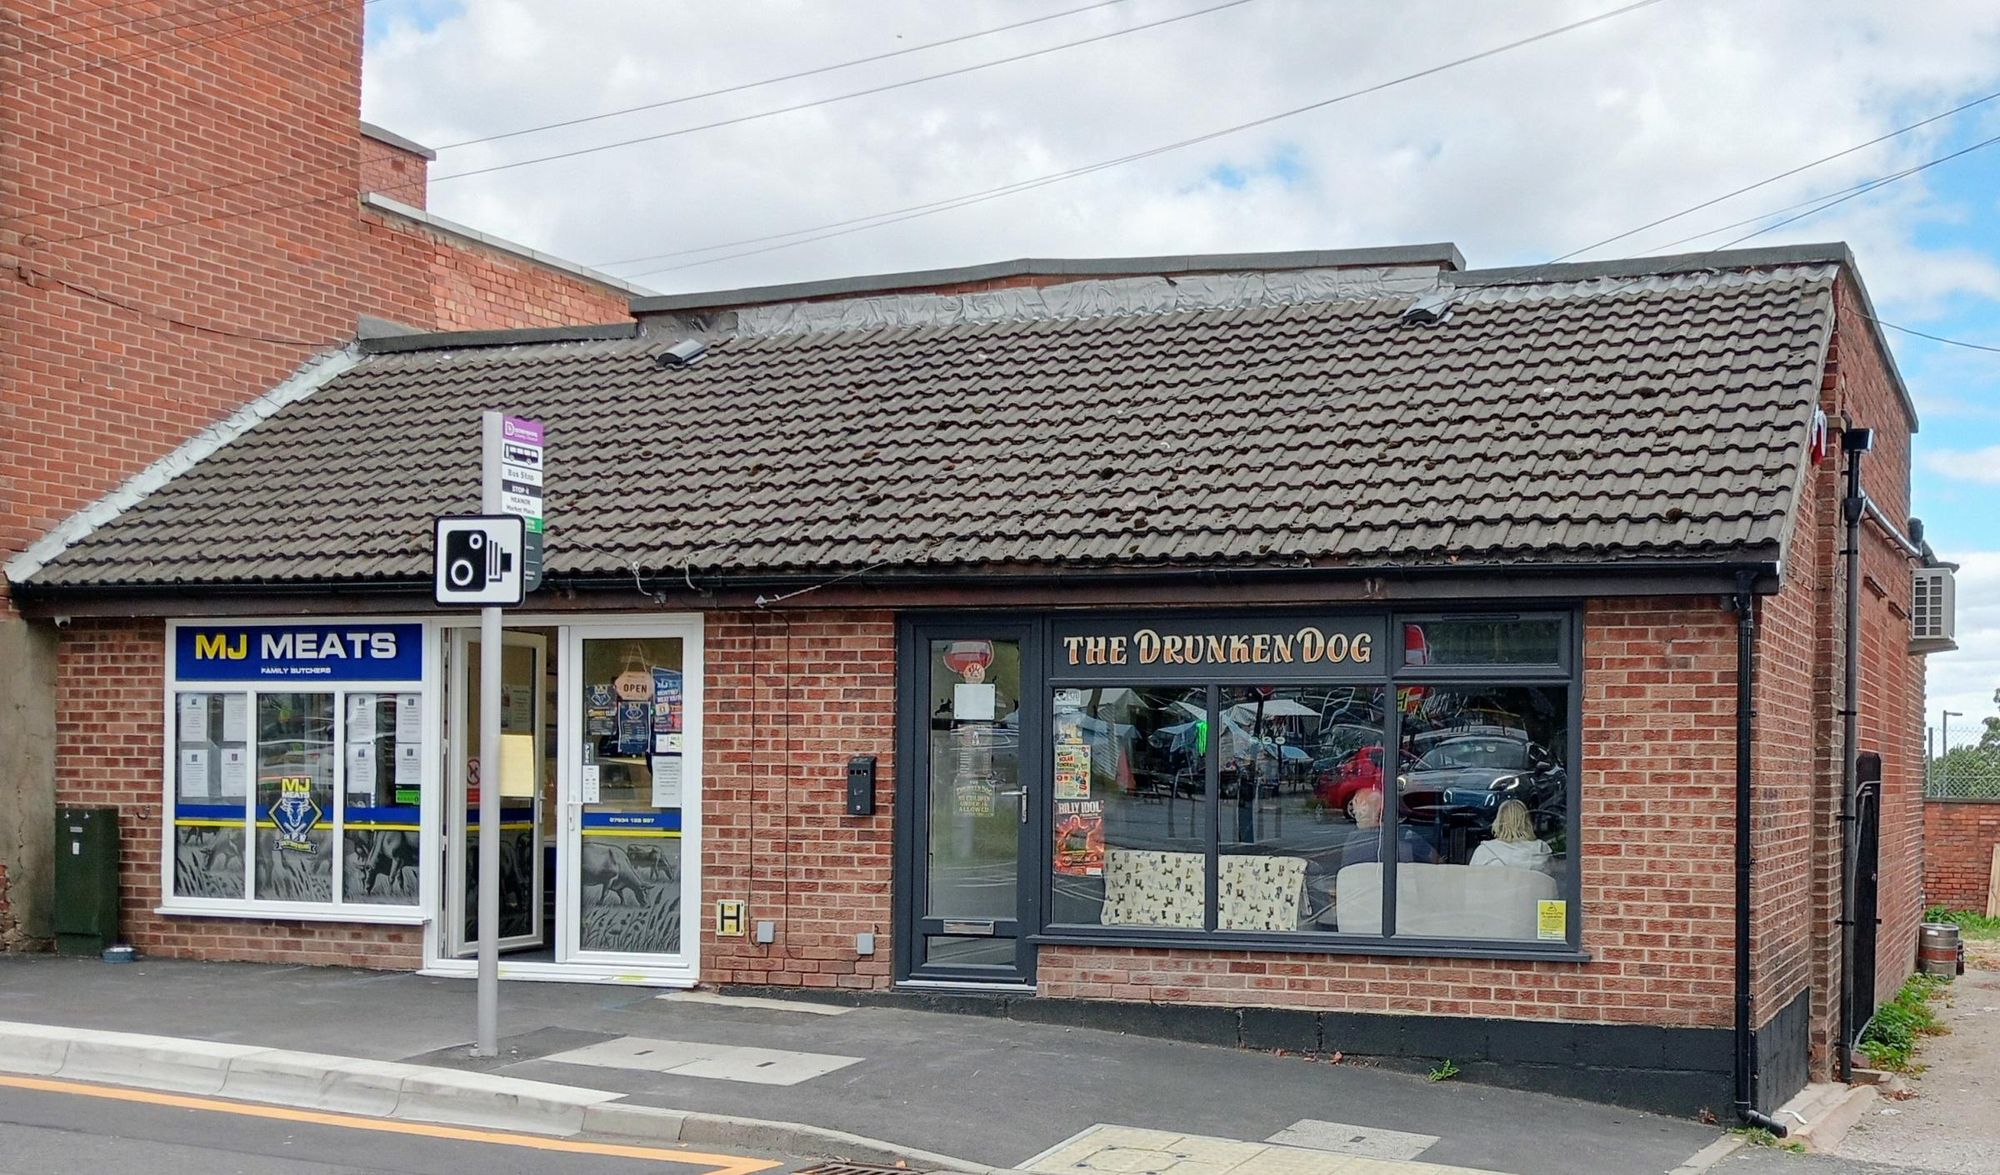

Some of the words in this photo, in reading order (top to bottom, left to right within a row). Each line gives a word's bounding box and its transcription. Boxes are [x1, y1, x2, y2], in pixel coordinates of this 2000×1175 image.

[508, 468, 519, 478] Bus
[520, 471, 535, 481] Stop
[511, 485, 525, 494] STOP
[195, 633, 248, 660] MJ
[260, 632, 397, 660] MEATS
[1063, 635, 1128, 666] THE
[260, 667, 289, 675] FAMILY
[289, 667, 332, 675] BUTCHERS
[623, 683, 648, 693] OPEN
[281, 777, 311, 792] MJ
[281, 791, 311, 799] MEATS
[1058, 801, 1080, 815] BILLY
[1081, 800, 1102, 814] IDOL
